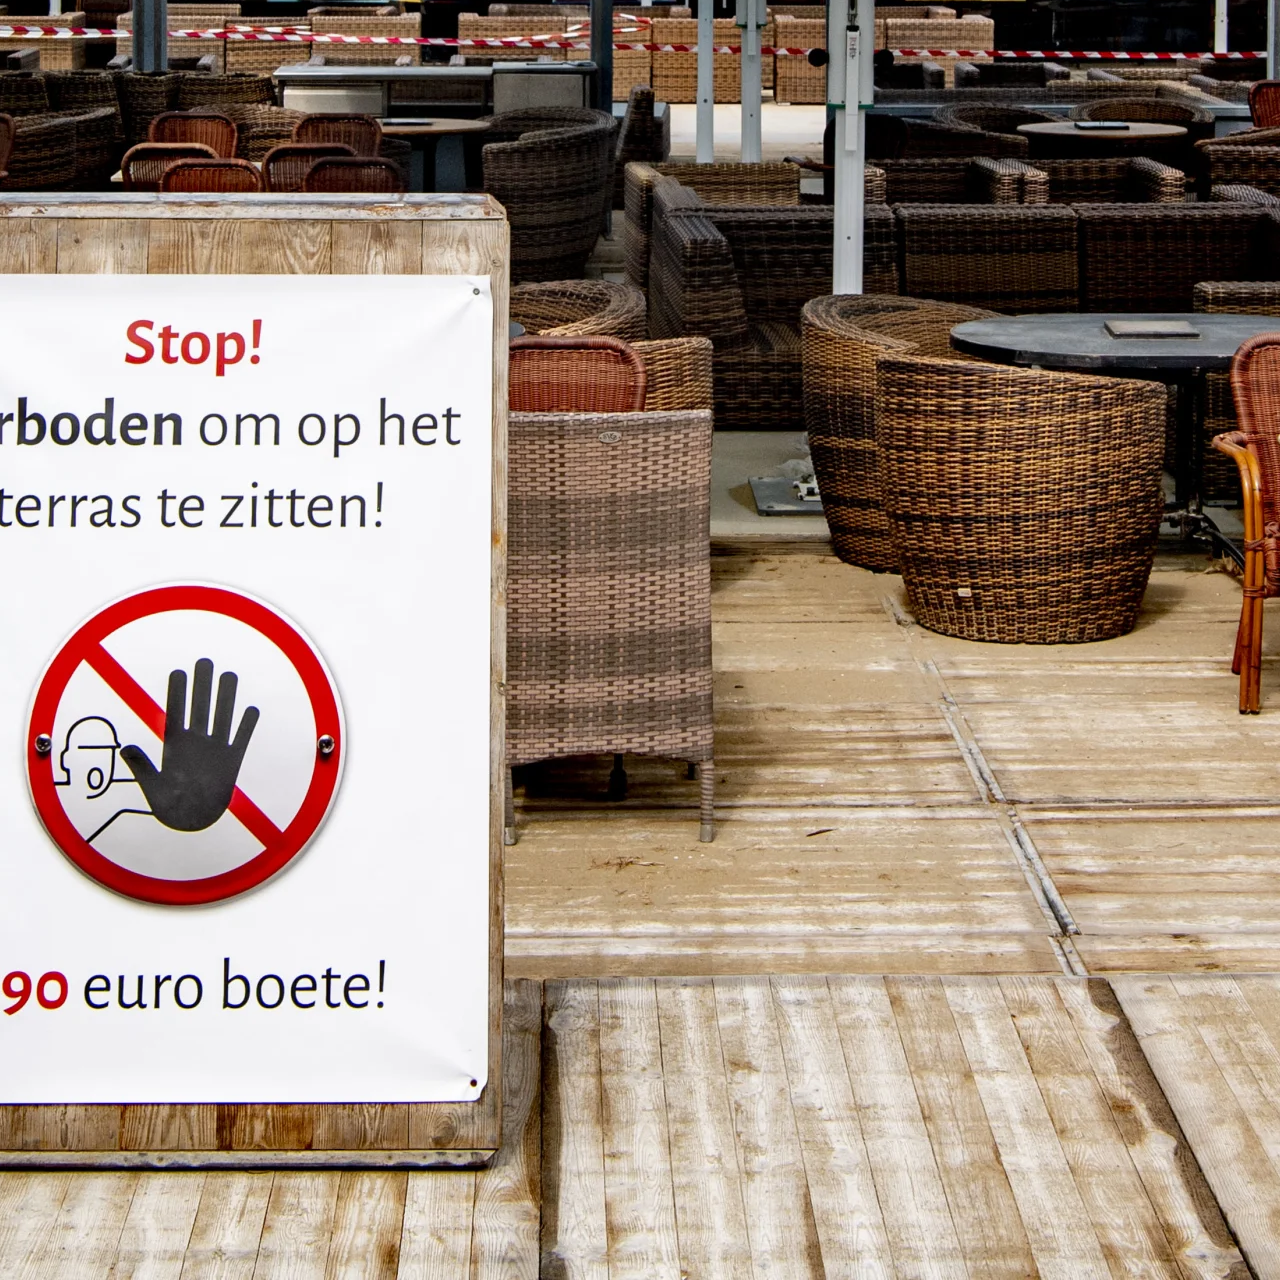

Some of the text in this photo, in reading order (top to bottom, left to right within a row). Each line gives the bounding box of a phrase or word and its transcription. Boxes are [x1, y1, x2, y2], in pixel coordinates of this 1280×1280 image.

[124, 318, 263, 377] Stop!
[199, 413, 280, 447] om
[298, 413, 361, 459] op
[379, 397, 462, 446] het
[157, 488, 205, 529] te
[219, 481, 384, 528] zitten!
[83, 974, 204, 1010] euro
[222, 956, 387, 1010] boete!
